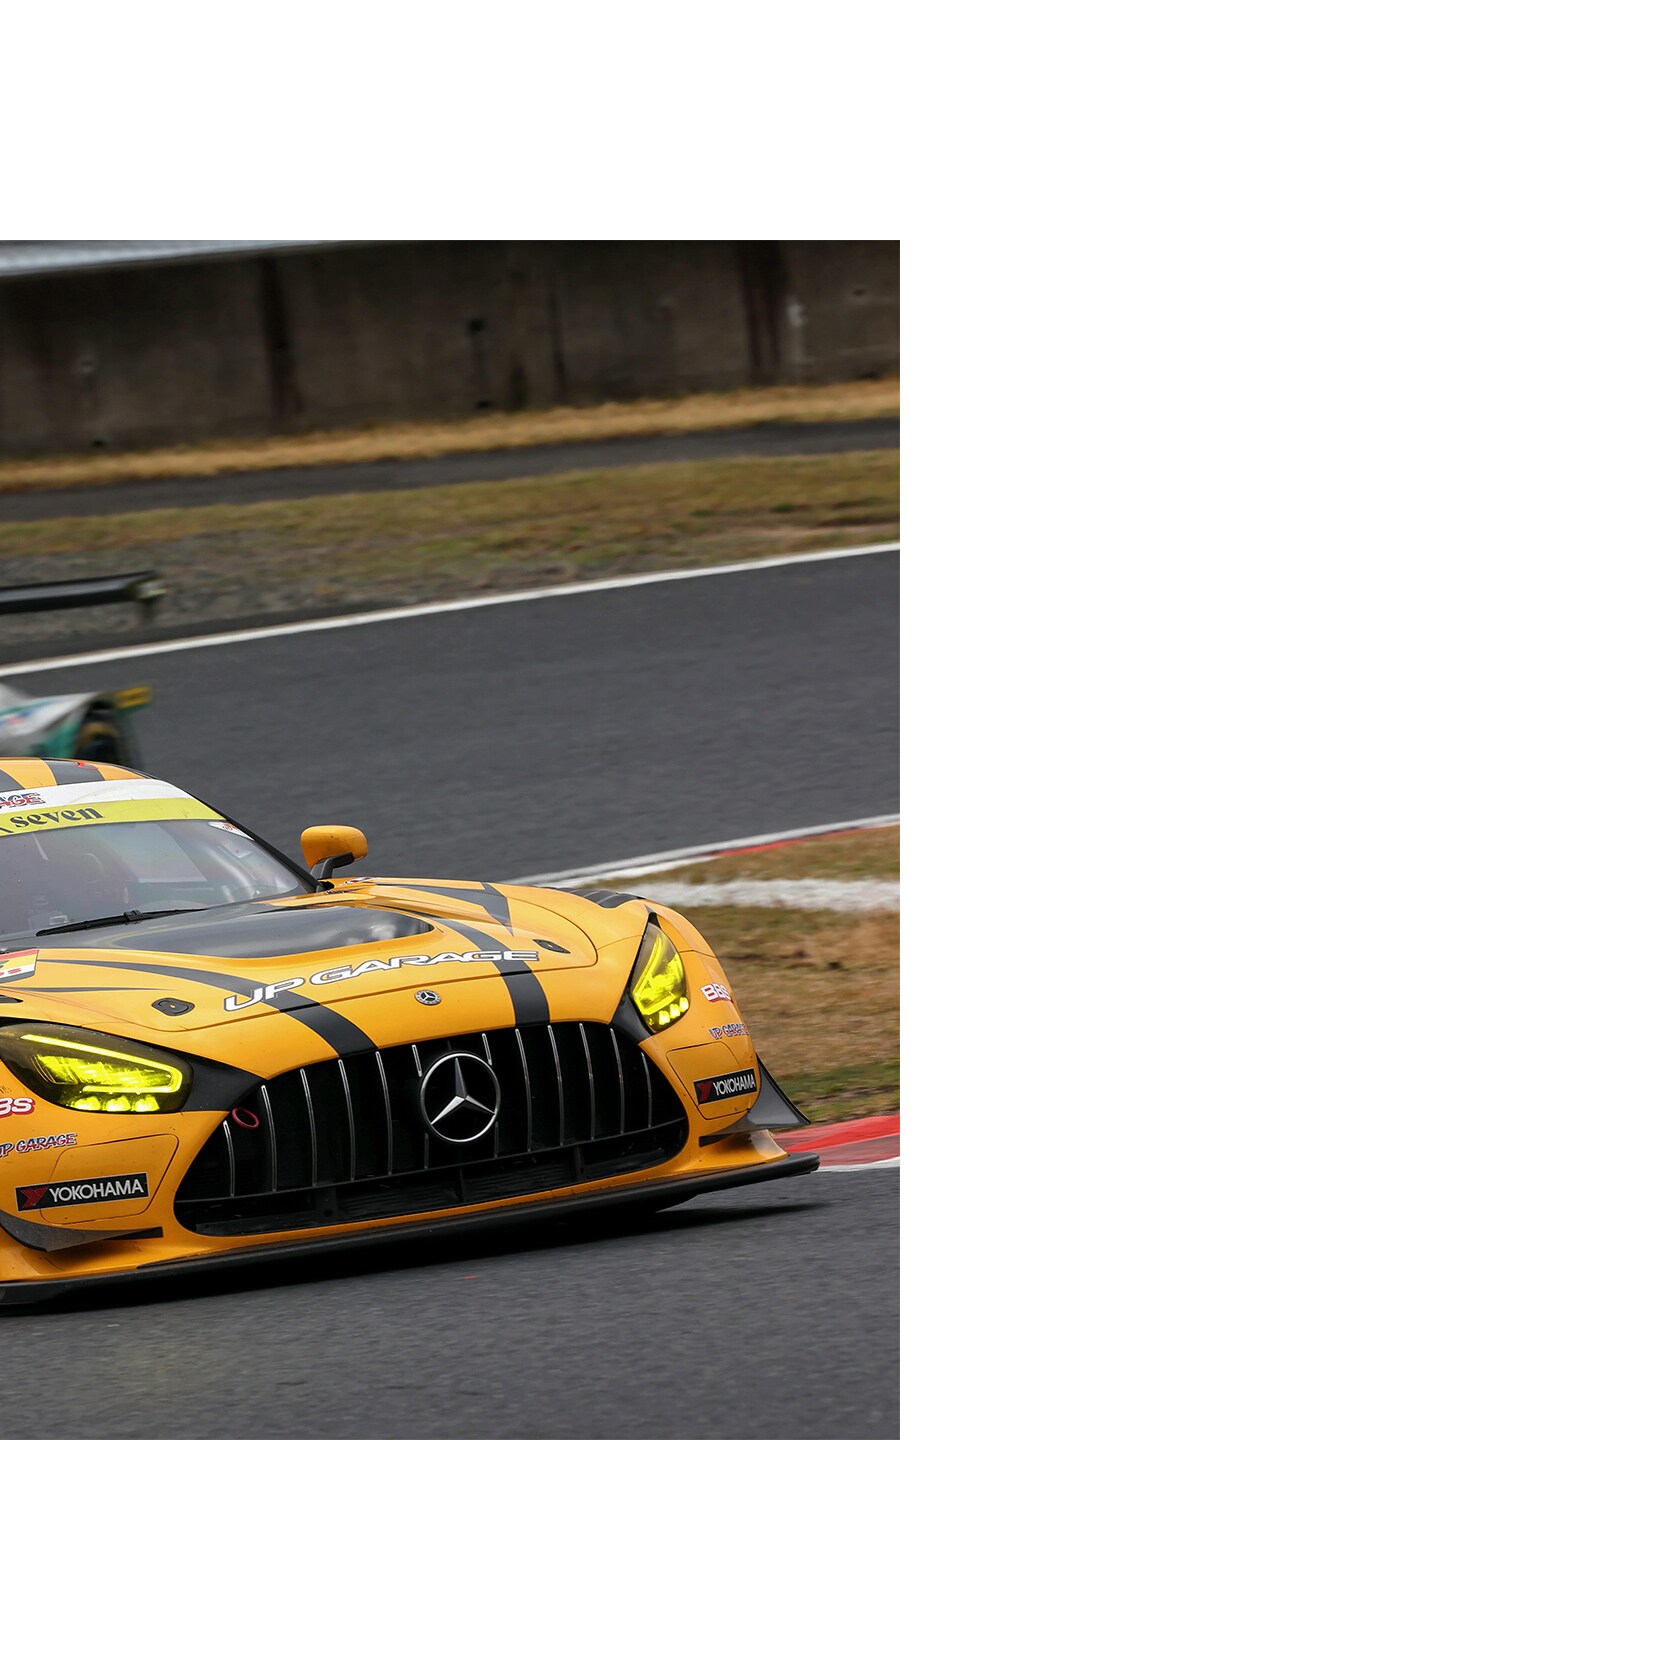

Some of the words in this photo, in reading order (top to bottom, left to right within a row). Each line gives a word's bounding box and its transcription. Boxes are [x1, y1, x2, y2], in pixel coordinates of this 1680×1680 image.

[10, 806, 105, 829] seven
[223, 976, 306, 1012] UP
[308, 950, 540, 986] GARAGE
[713, 1073, 756, 1097] YOKOHAMA
[15, 1131, 78, 1154] GARAGE
[49, 1178, 145, 1203] YOKOHAMA
